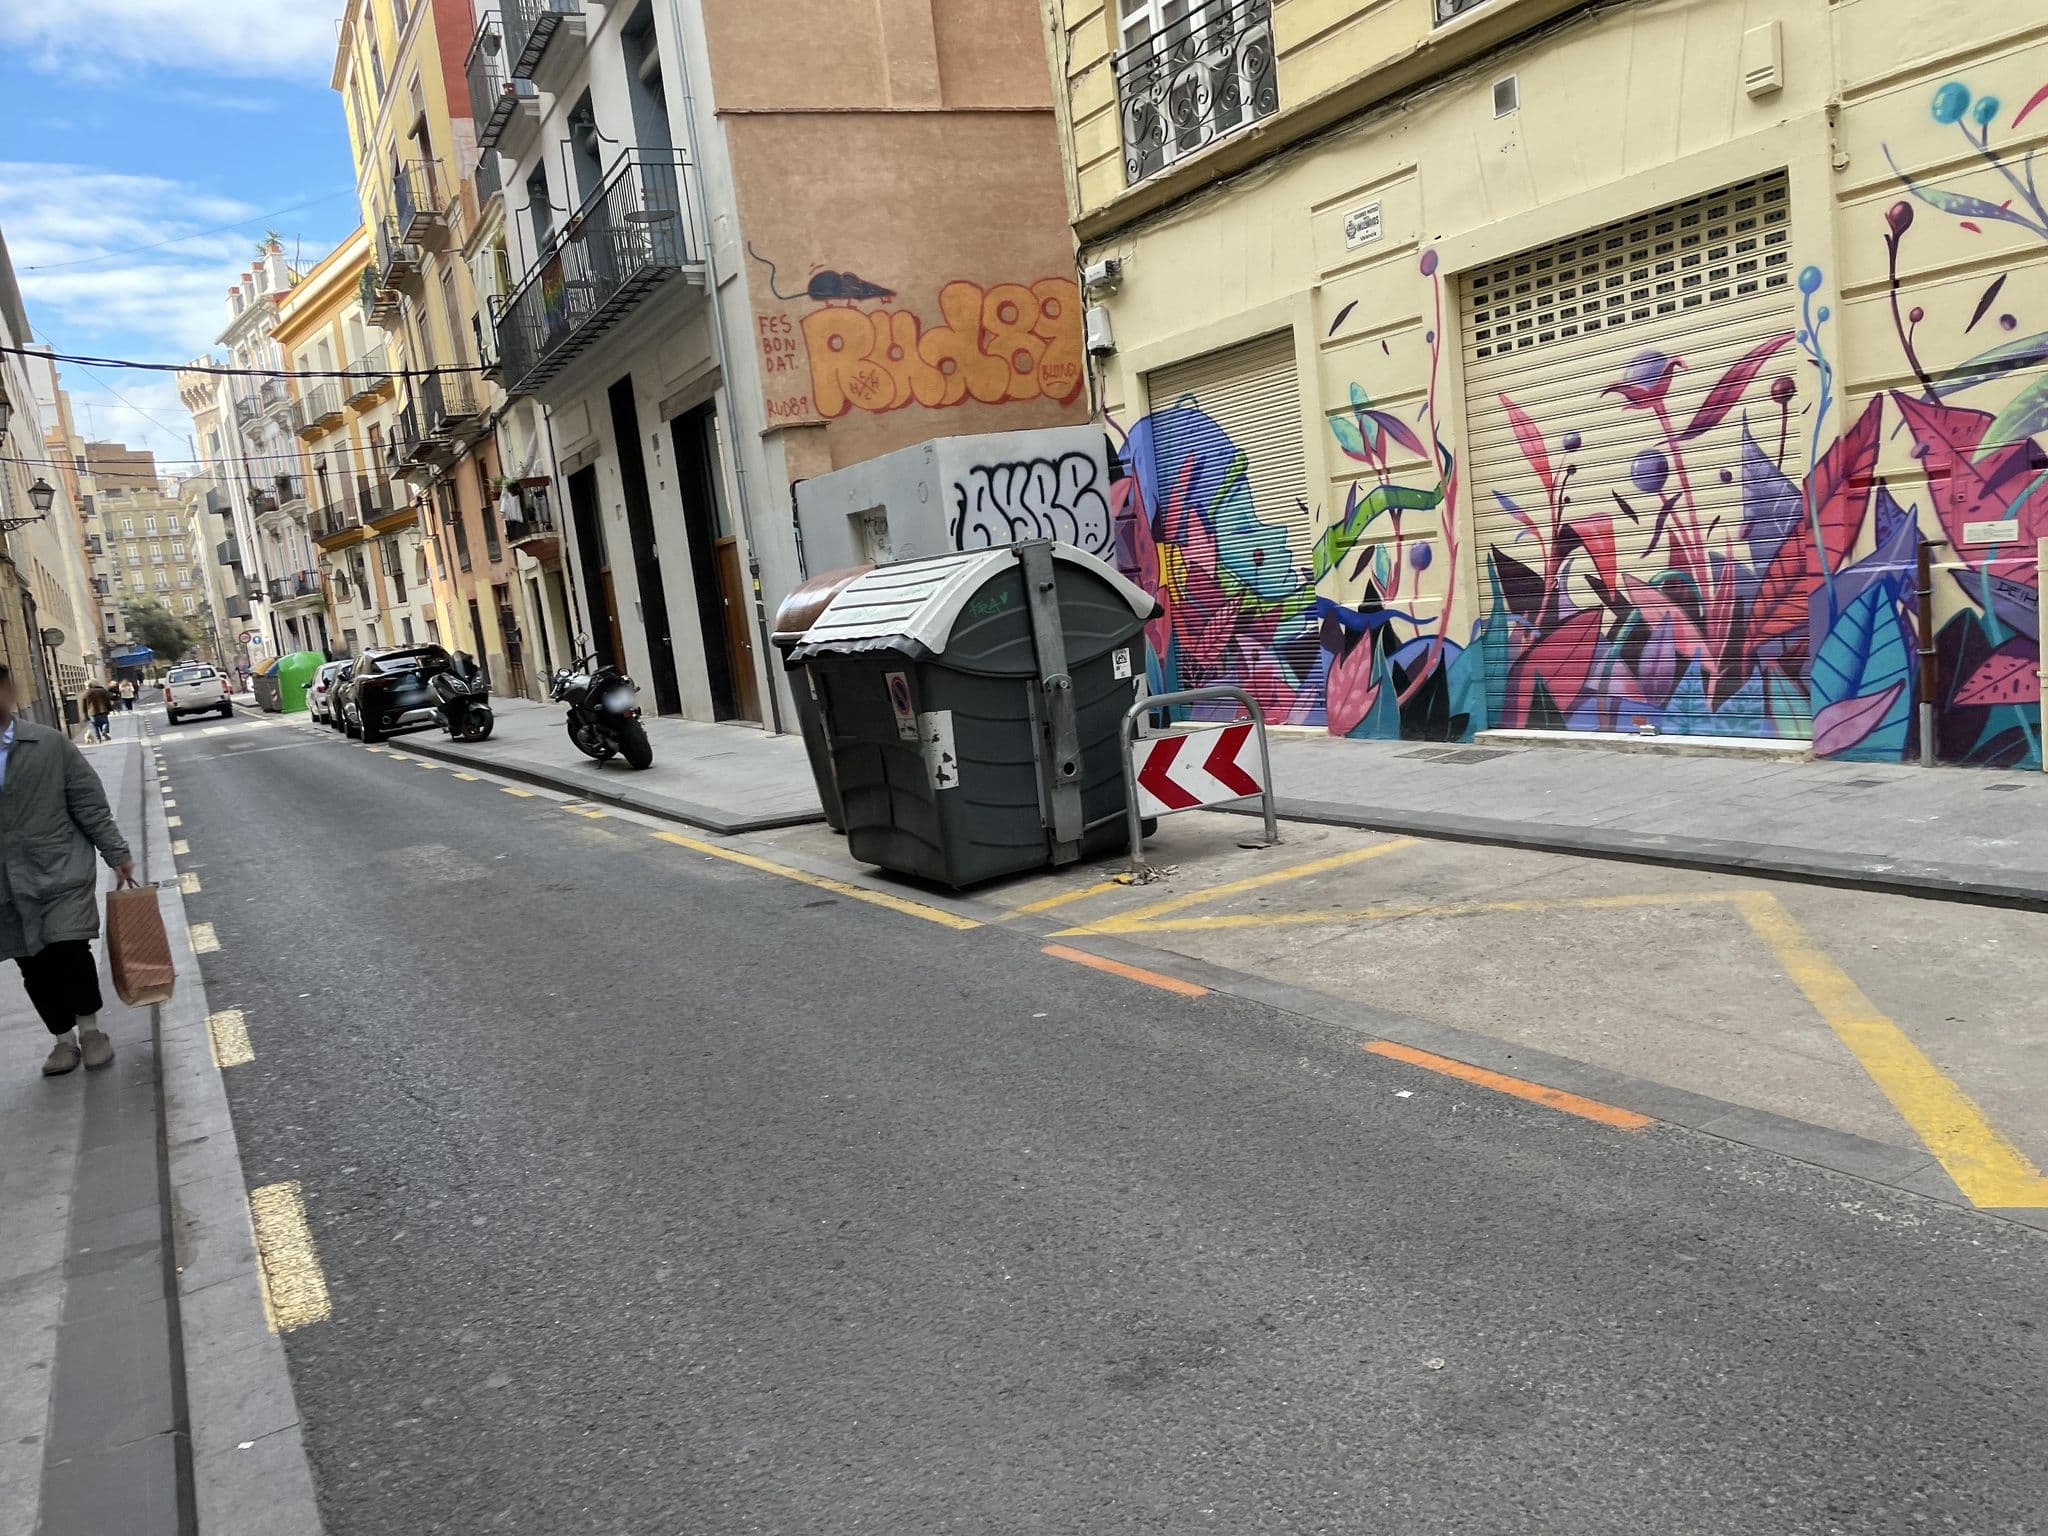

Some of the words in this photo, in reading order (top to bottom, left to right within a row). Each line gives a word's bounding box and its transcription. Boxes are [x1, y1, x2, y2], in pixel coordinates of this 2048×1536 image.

[758, 314, 792, 334] FES
[763, 337, 796, 354] BON
[766, 396, 809, 418] RUD89
